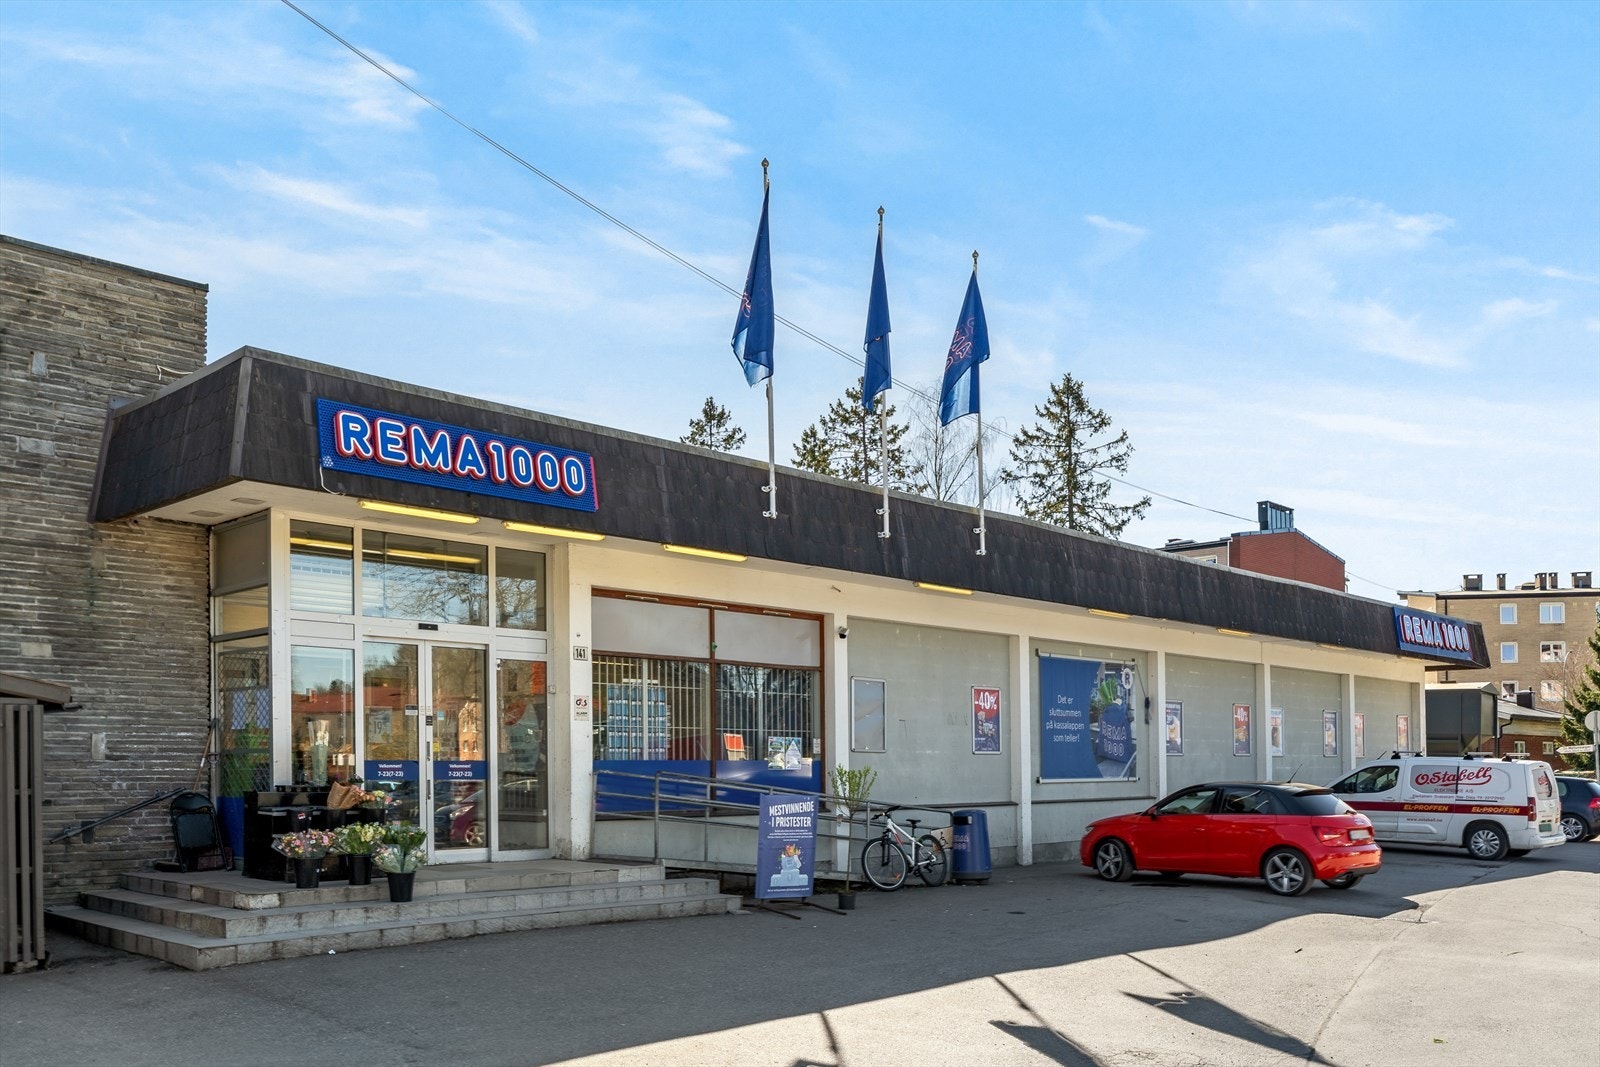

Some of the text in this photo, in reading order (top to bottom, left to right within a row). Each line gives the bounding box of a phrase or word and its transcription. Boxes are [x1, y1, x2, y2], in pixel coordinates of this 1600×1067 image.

[575, 648, 586, 659] 141
[974, 691, 998, 710] -40%
[1057, 694, 1074, 704] Det er
[1048, 706, 1082, 717] sluttsummen
[1046, 720, 1085, 731] på kassalappen
[1101, 720, 1127, 741] REMA
[1065, 733, 1080, 743] teller!
[448, 770, 473, 778] 7-23(7-23)
[769, 801, 815, 817] MESTVINNENDE
[1403, 804, 1449, 812] EL-PROFFEN
[1471, 806, 1520, 814] EL-PROFFEN
[775, 816, 812, 827] PRISTESTER
